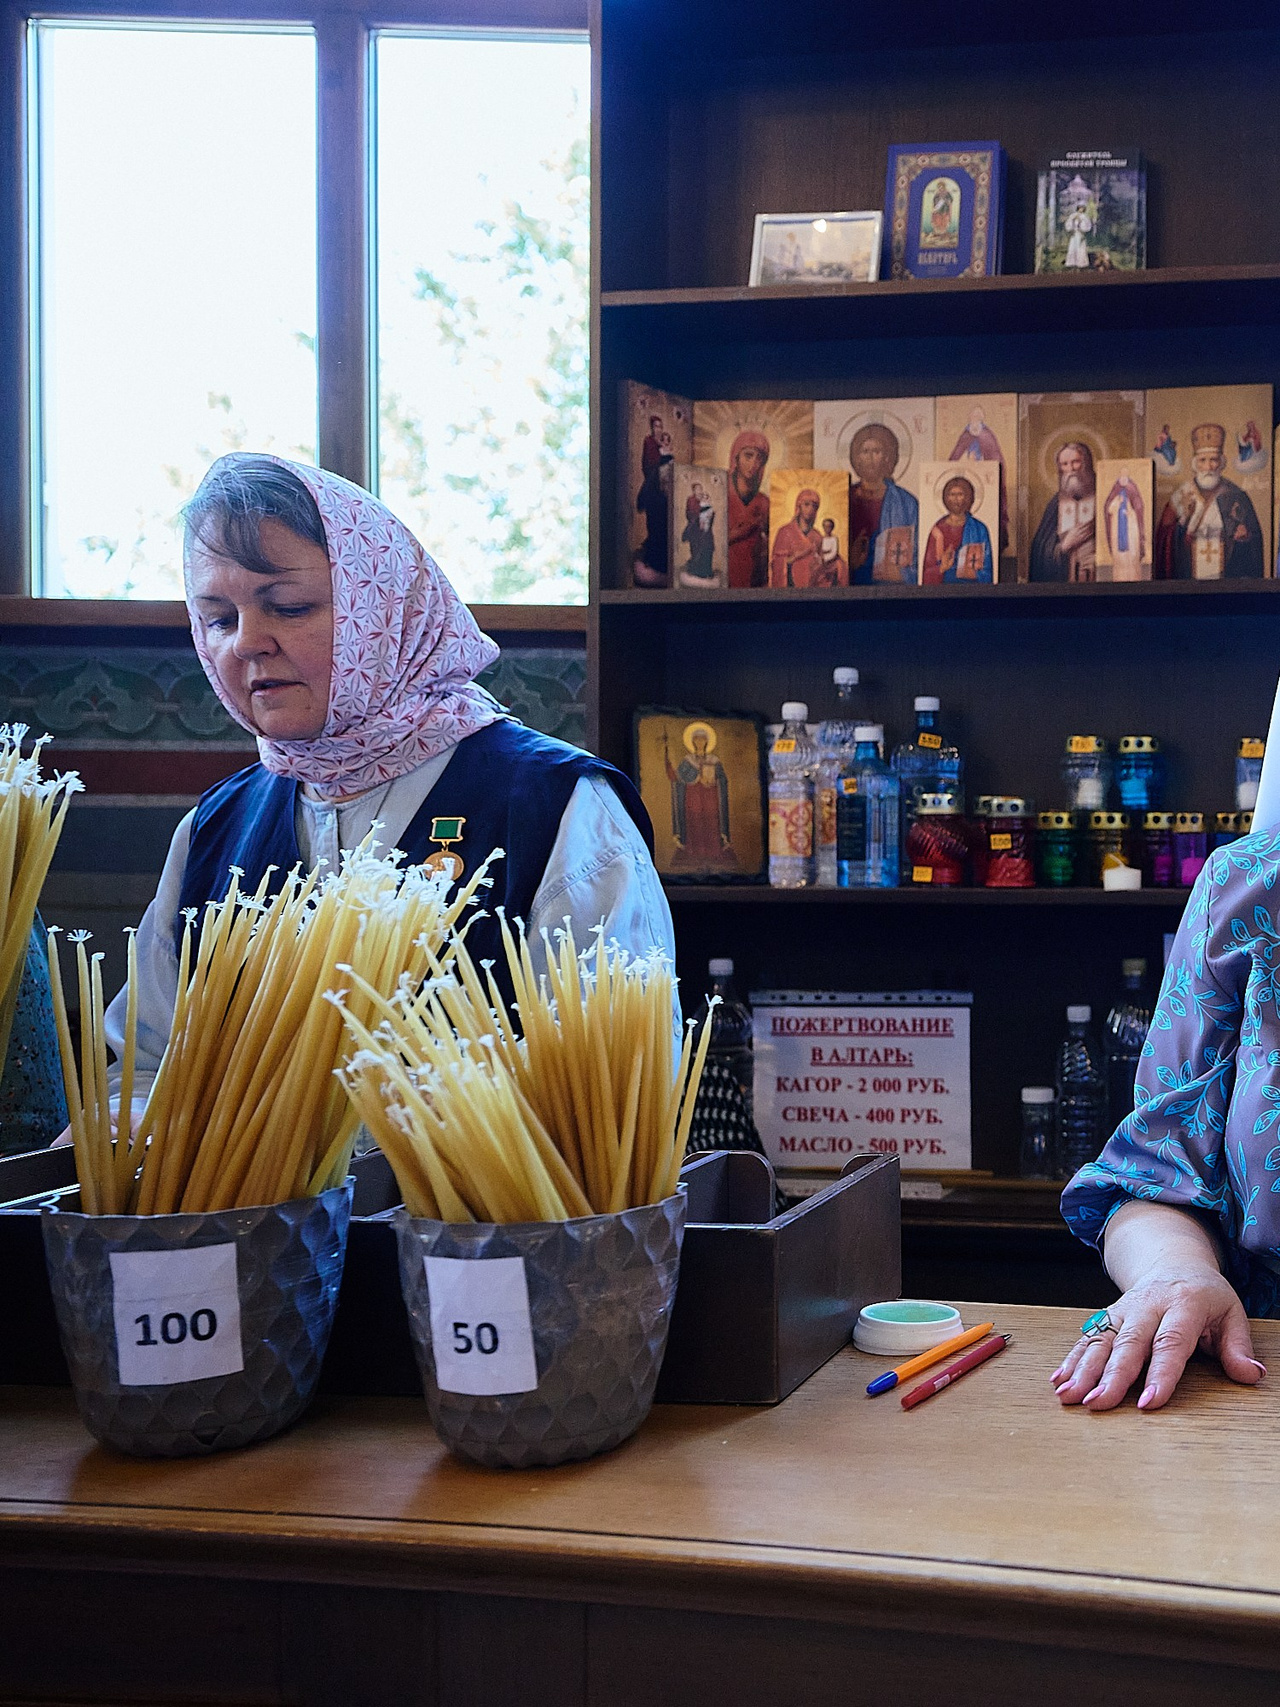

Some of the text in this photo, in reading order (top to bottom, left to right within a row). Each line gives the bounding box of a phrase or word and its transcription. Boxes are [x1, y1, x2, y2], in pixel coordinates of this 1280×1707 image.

[772, 1016, 954, 1034] ПОЖЕРТВОВАНИЕ
[811, 1047, 914, 1064] В АЛТАРЬ:
[776, 1076, 842, 1094] КАГОР
[907, 1077, 950, 1095] РУБ.
[782, 1106, 849, 1123] СВЕЧА
[865, 1107, 895, 1124] 400
[900, 1107, 943, 1125] РУБ.
[779, 1136, 853, 1154] МАСЛО
[869, 1137, 898, 1154] 500
[903, 1137, 947, 1156] РУБ.
[135, 1308, 217, 1346] 100
[453, 1322, 499, 1354] 50
